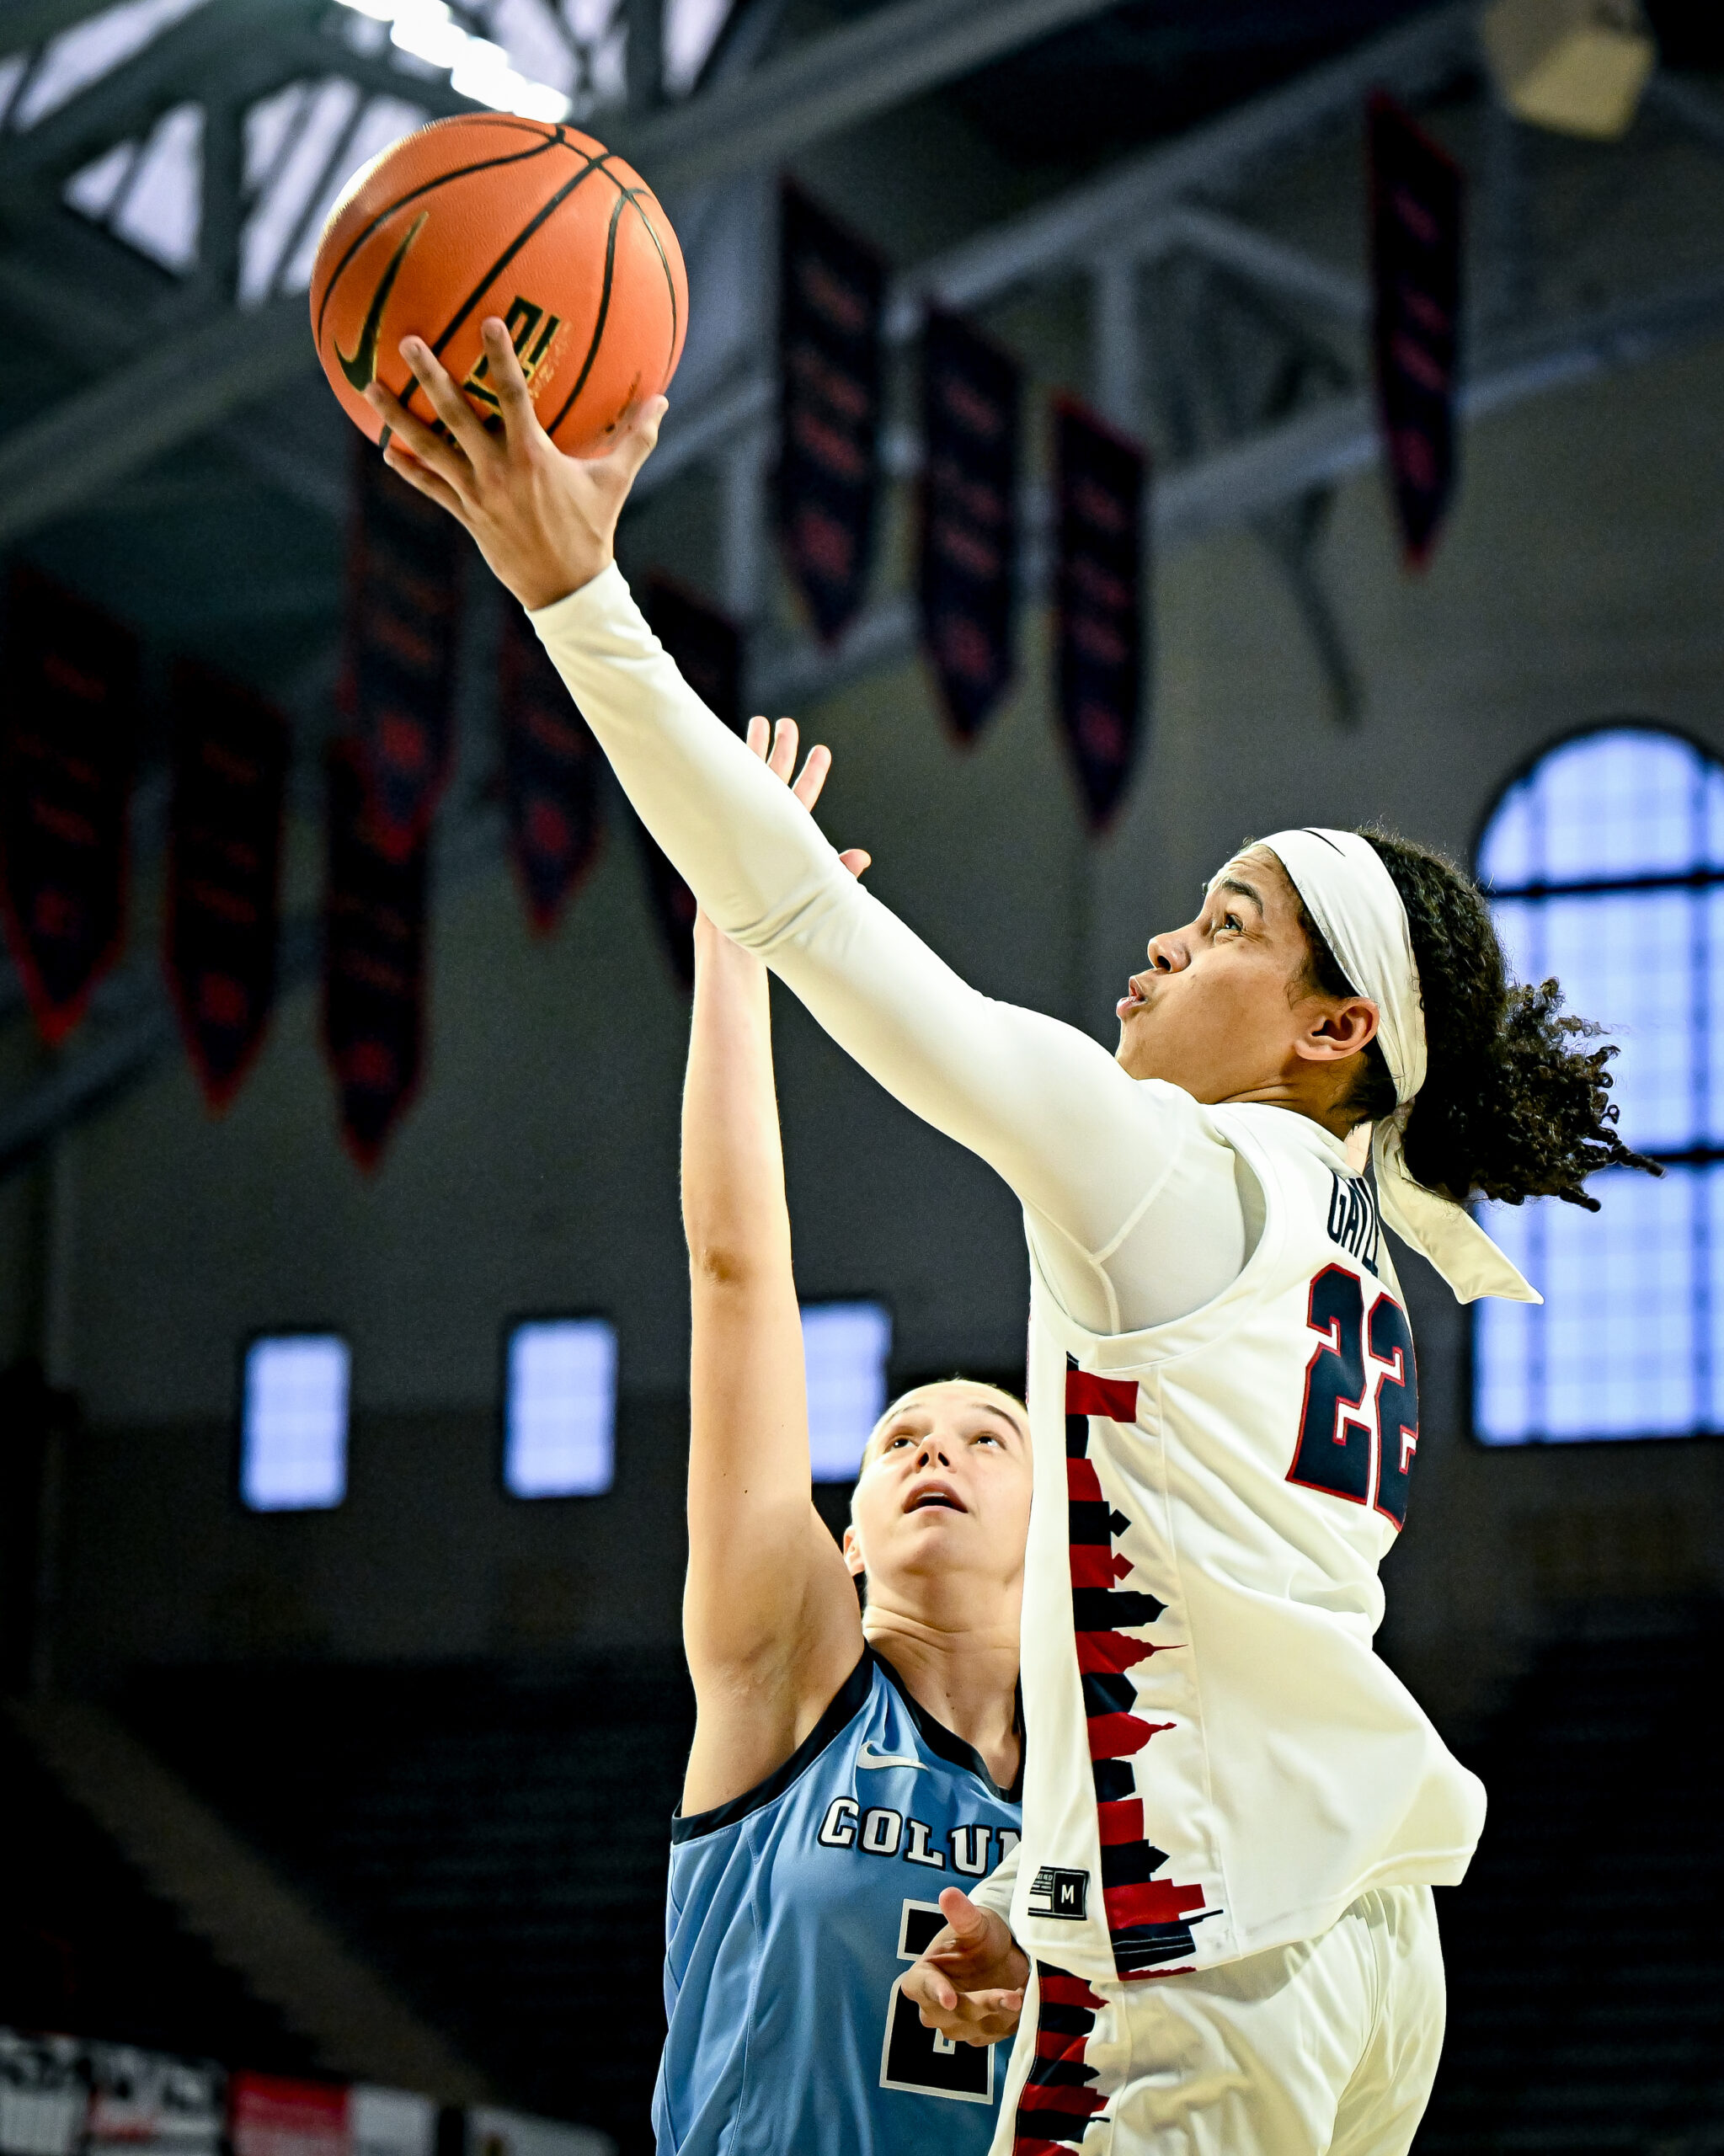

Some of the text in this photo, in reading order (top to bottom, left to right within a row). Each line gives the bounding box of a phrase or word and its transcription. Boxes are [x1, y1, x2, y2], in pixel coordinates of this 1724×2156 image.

[1326, 1170, 1379, 1278] GAYL
[1285, 1262, 1419, 1532] 22
[1061, 1884, 1075, 1904] M
